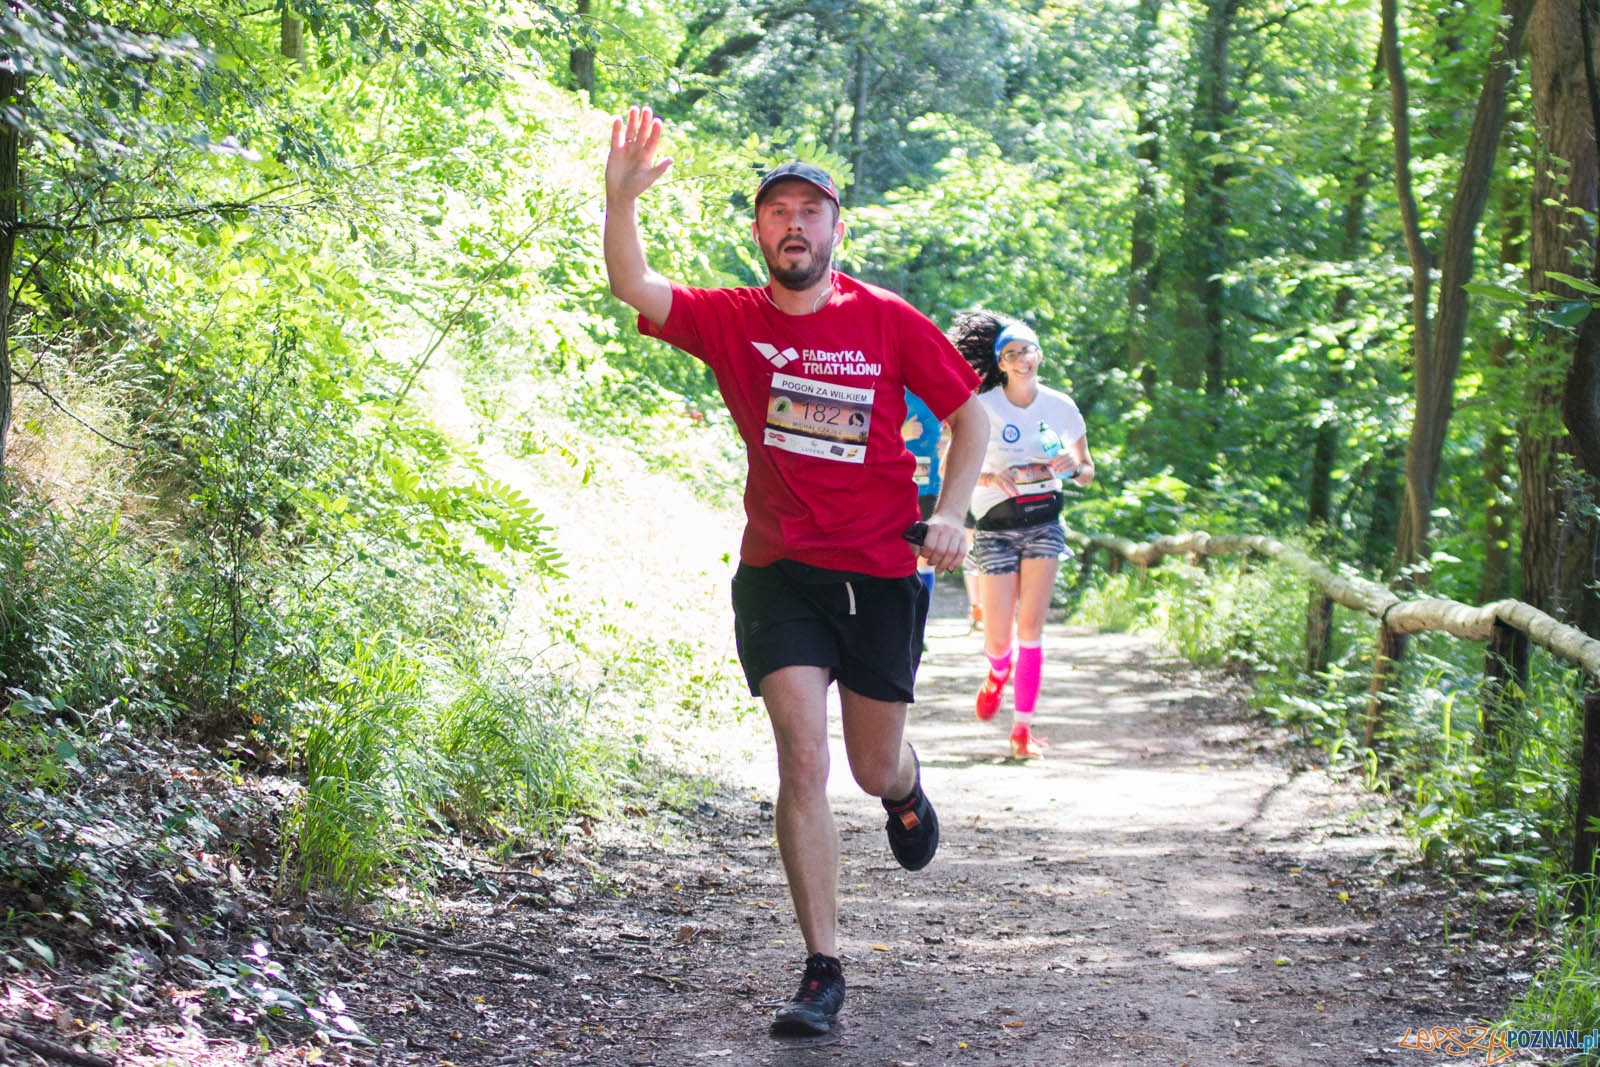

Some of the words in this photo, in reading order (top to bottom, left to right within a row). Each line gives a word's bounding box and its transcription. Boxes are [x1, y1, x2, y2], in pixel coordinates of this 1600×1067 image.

[802, 349, 866, 362] FABRYKA
[802, 363, 881, 376] TRIATHLONU
[782, 380, 814, 393] POGOŃ
[815, 387, 828, 396] ZA
[830, 390, 868, 402] WILKIEM
[802, 400, 841, 426] 182
